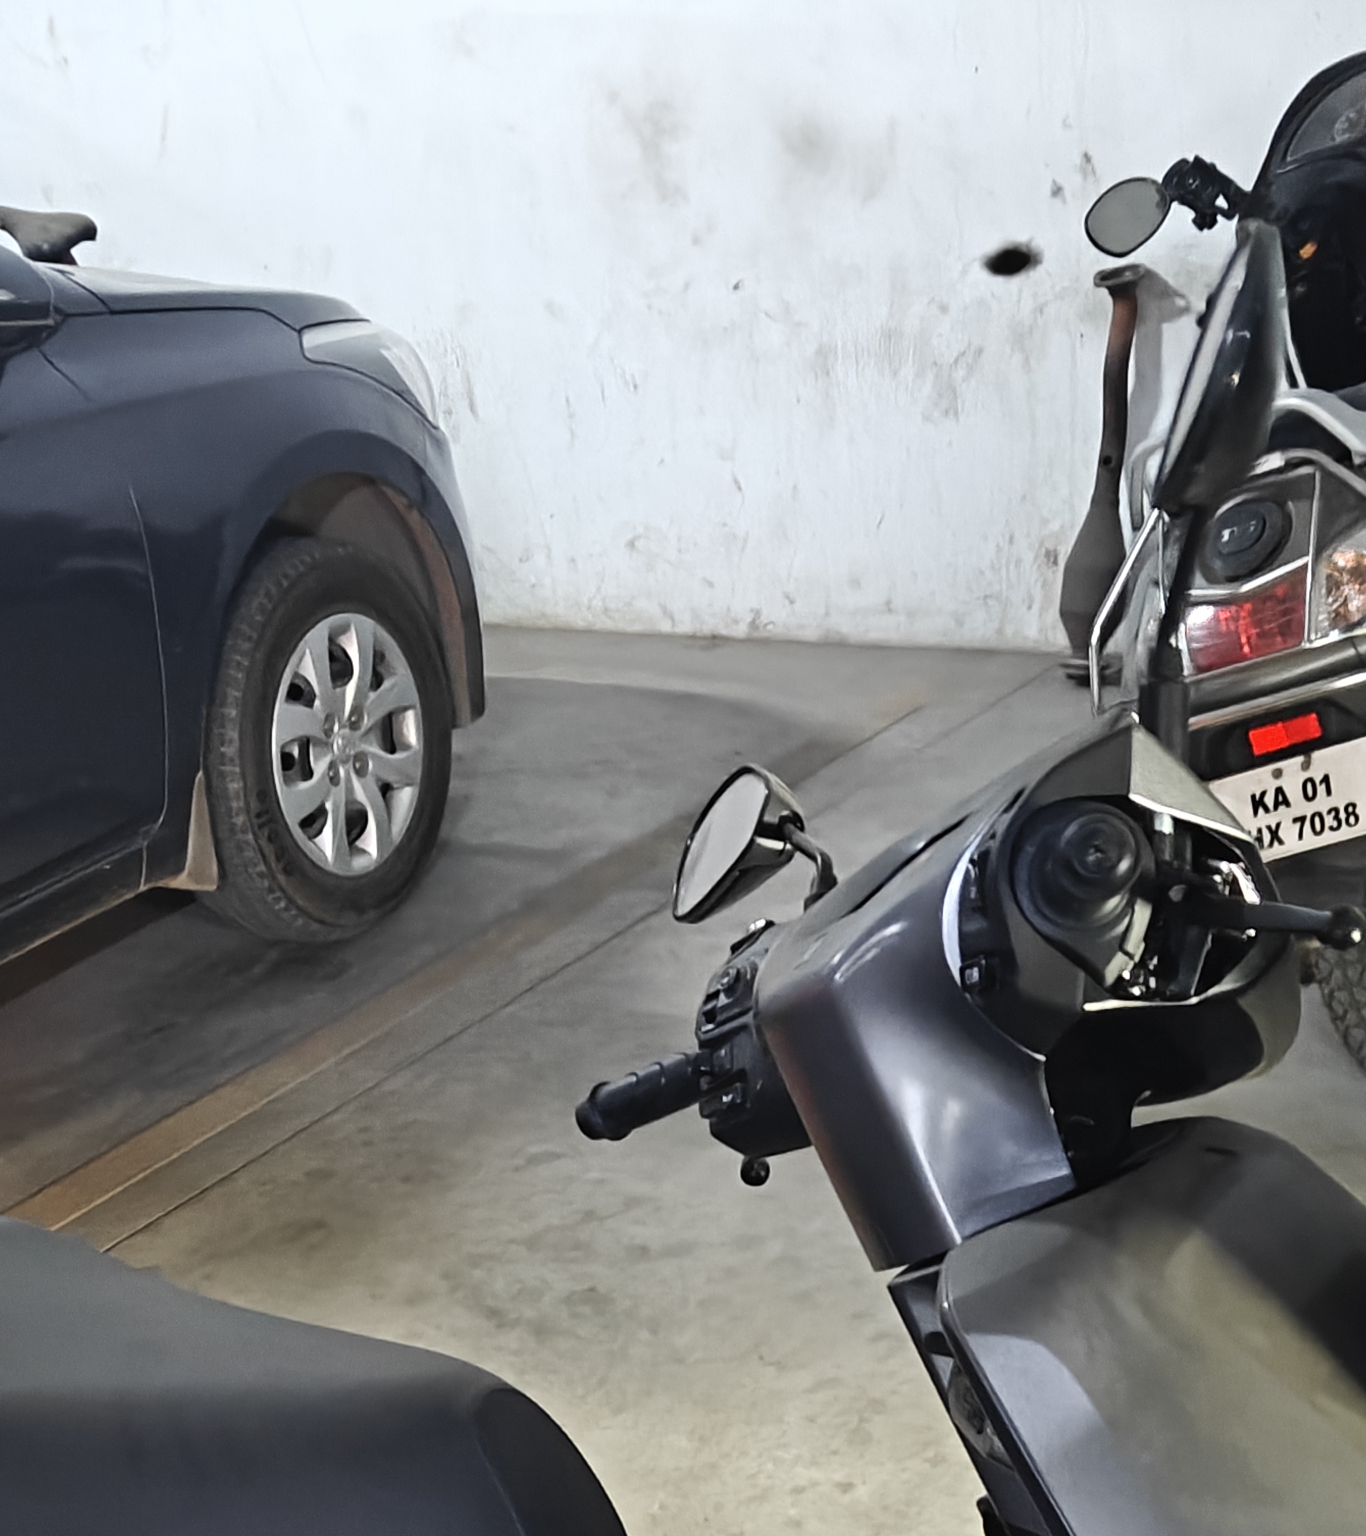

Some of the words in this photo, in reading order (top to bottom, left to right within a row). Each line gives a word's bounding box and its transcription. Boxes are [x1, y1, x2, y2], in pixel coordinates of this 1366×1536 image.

[1250, 785, 1291, 818] KA
[1301, 773, 1333, 802] 01
[1292, 802, 1360, 841] 7038
